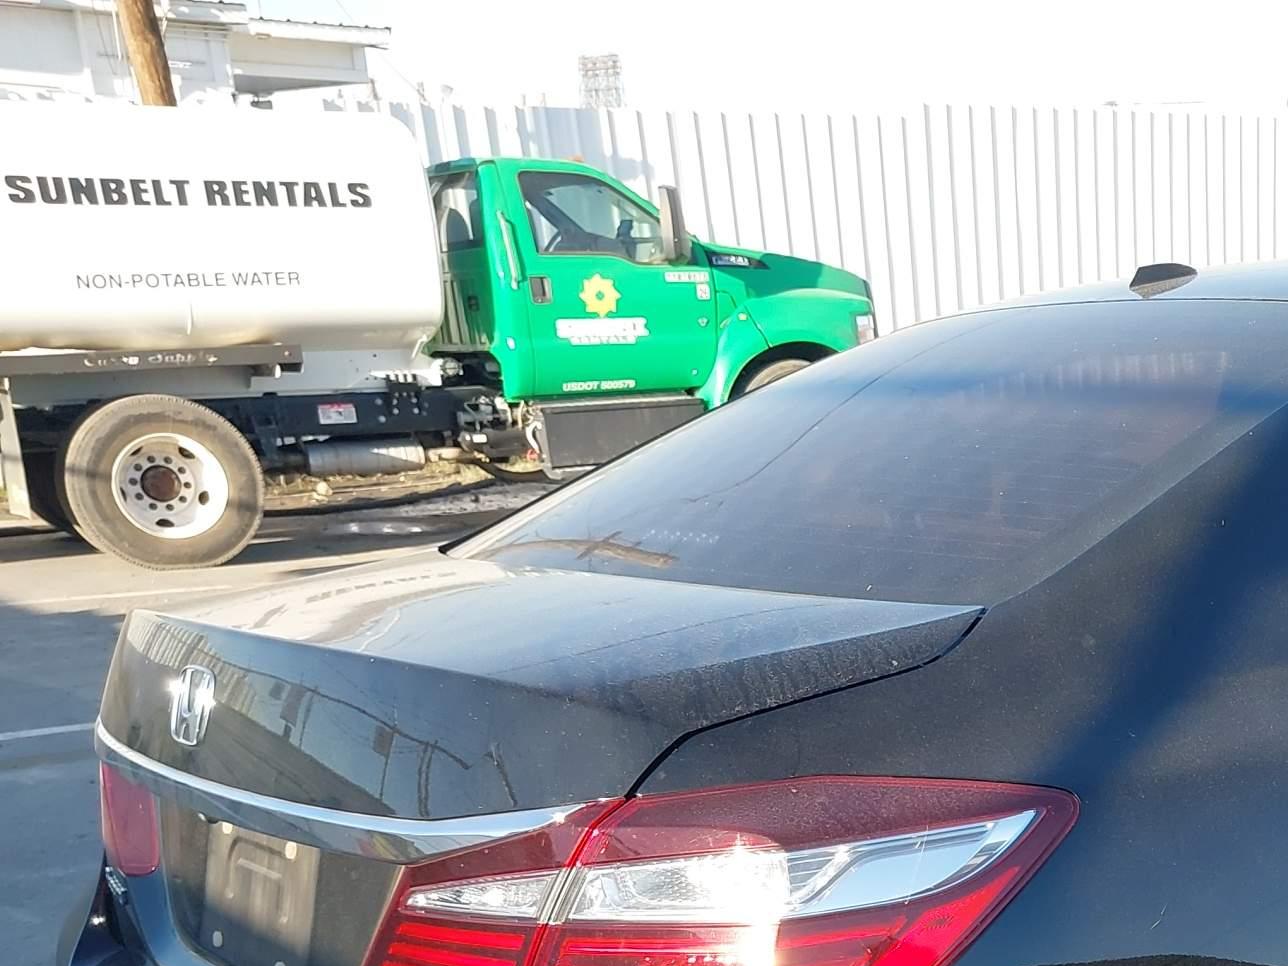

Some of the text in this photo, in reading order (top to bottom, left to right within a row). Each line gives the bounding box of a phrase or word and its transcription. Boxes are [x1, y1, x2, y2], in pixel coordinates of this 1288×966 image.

[4, 175, 372, 208] SUNBELT RENTALS
[76, 271, 301, 289] NON-POTABLE WATER
